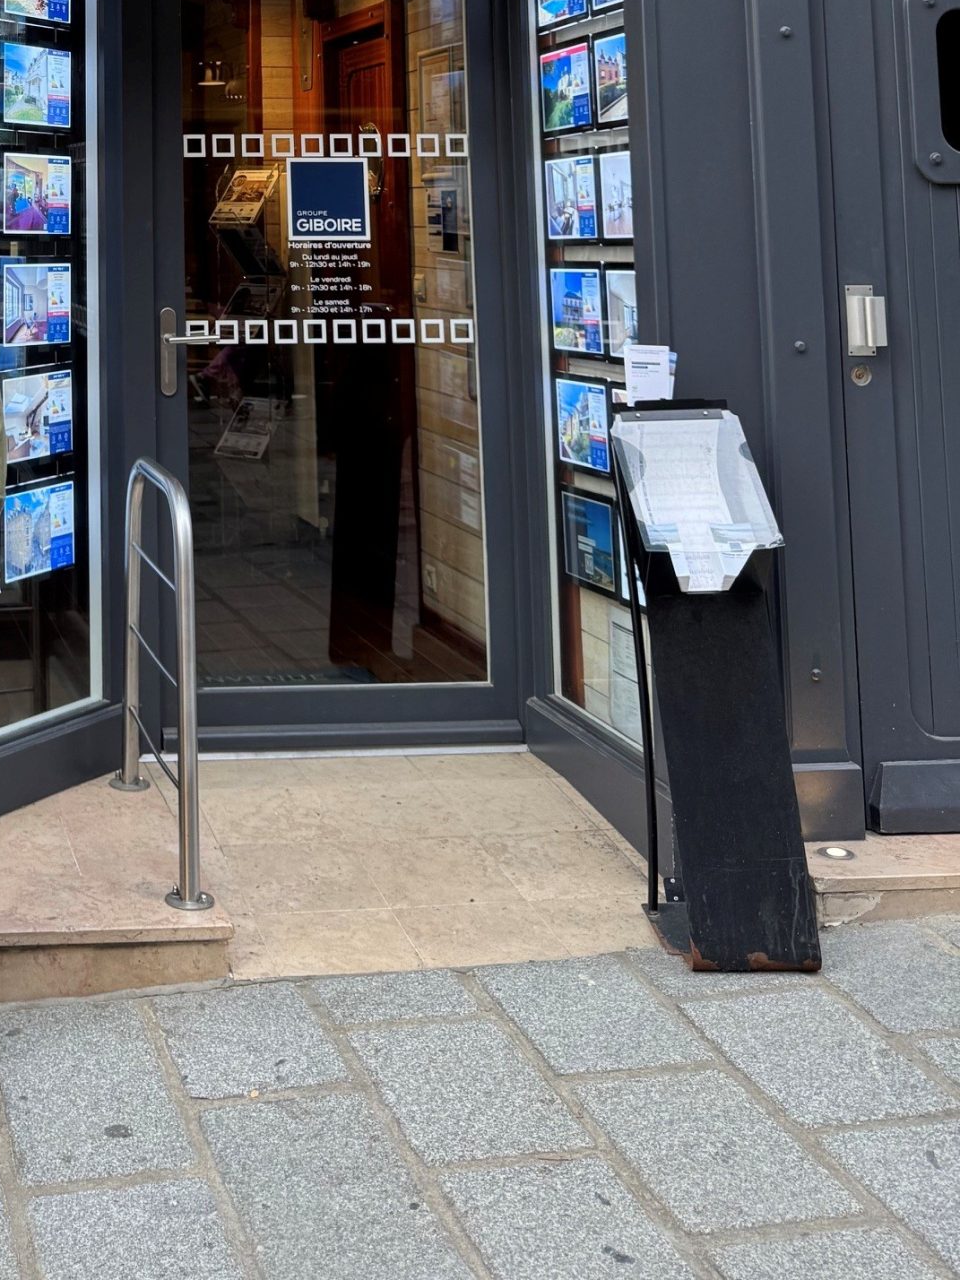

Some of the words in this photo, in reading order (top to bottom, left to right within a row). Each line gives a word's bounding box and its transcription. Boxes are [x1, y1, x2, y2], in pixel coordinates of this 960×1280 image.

[296, 218, 361, 231] GIBOIRE
[341, 254, 358, 262] jeudi
[359, 305, 372, 313] 17h
